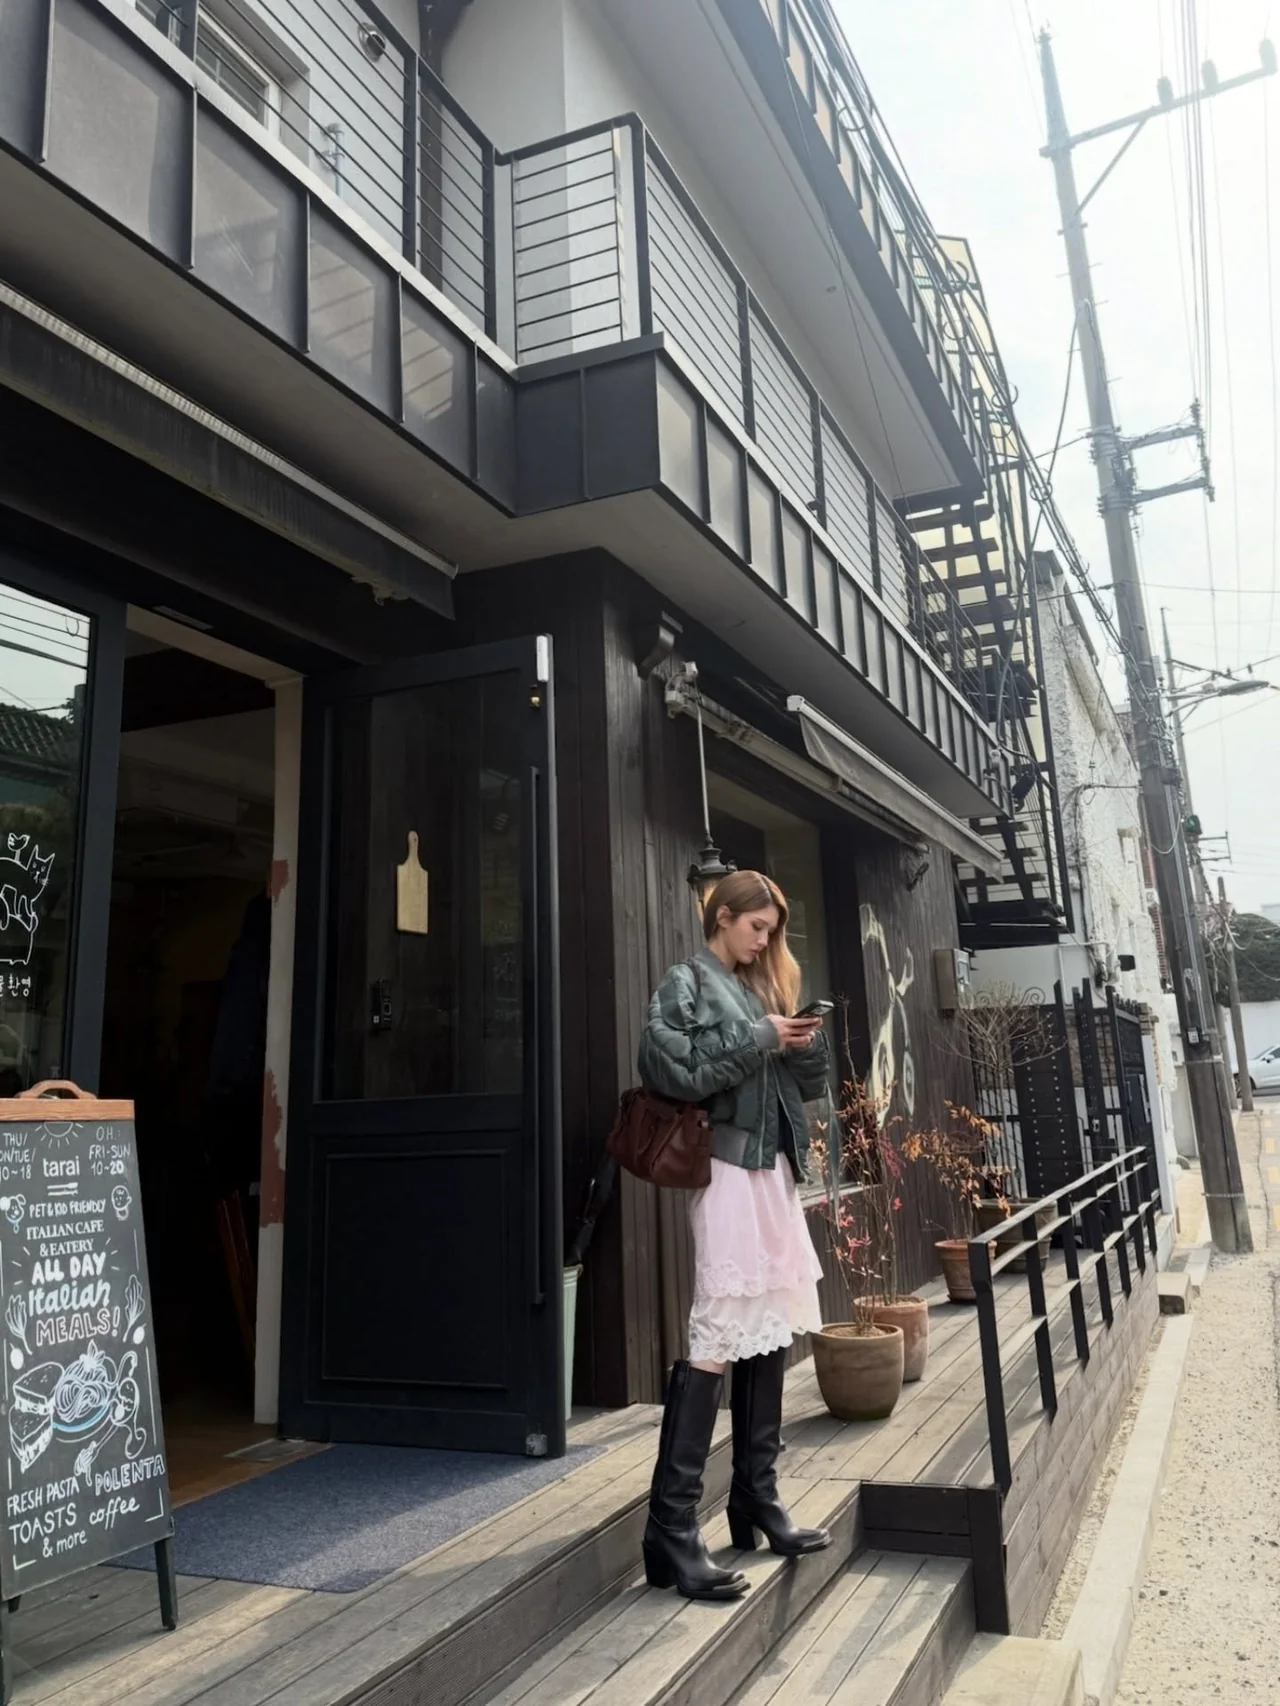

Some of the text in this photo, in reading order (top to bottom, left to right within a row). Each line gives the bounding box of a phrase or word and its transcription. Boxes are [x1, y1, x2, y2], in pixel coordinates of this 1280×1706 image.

[43, 1155, 80, 1177] tarai
[69, 1199, 106, 1215] FRIENDLY
[26, 1219, 105, 1240] ITALIAN CAFE
[40, 1238, 94, 1257] & EATERY
[31, 1251, 107, 1286] ALL DAY
[28, 1279, 111, 1317] Italian
[36, 1306, 121, 1347] MEALS!
[95, 1454, 165, 1496] POLENTA
[7, 1476, 80, 1517] FRESH PASTA
[89, 1496, 140, 1530] coffee
[9, 1502, 77, 1545] TOASTS
[42, 1530, 87, 1558] & more
